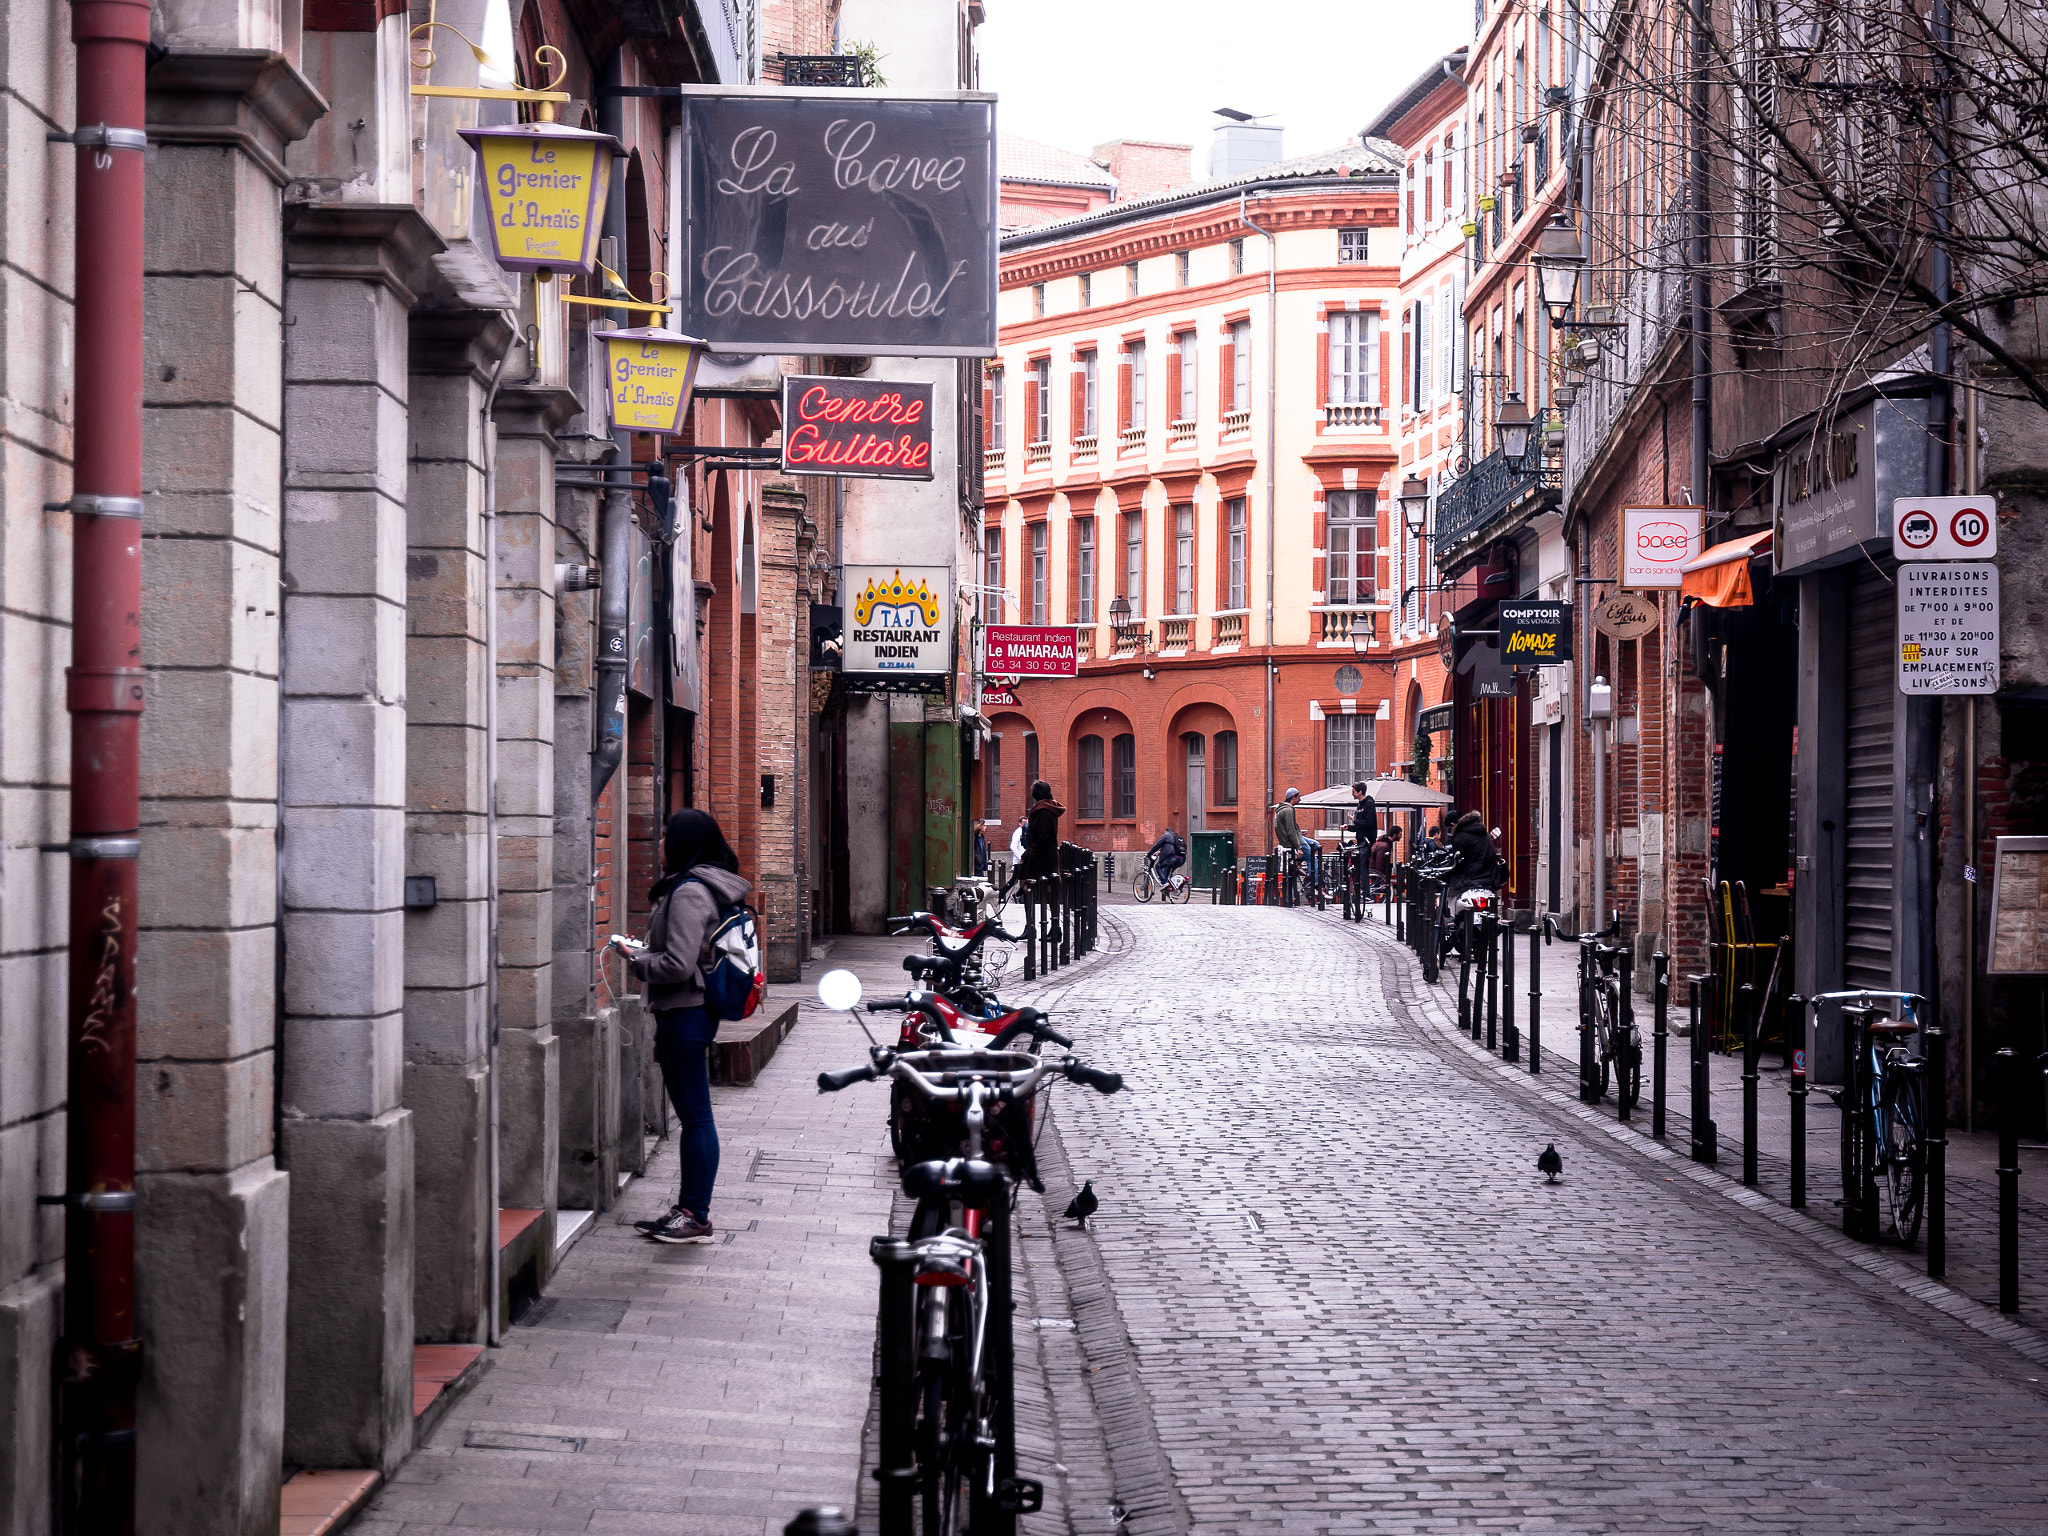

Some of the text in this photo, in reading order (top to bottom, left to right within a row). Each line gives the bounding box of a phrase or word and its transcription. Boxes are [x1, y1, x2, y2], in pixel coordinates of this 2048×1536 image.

[531, 141, 556, 164] Le
[717, 118, 966, 195] La Cave
[501, 200, 580, 229] d'Anaïs
[701, 246, 971, 319] Cassoulet
[641, 342, 659, 359] Le
[617, 383, 675, 407] d'Anaïs
[799, 384, 924, 424] Centre
[786, 423, 930, 468] Guitare
[1959, 519, 1981, 536] 10
[1637, 531, 1688, 549] boca
[1629, 566, 1644, 574] bar
[1909, 571, 1989, 581] LIVRAISONS
[1910, 587, 1988, 597] INTERDITES
[881, 609, 915, 628] TAJ
[1503, 609, 1560, 619] COMPTOIR
[853, 629, 941, 643] RESTAURANT
[992, 631, 1072, 643] Restaurant Indien
[1506, 630, 1557, 653] NOMADE
[874, 645, 919, 658] INDIEN
[988, 643, 1074, 659] Le MAHARAJA
[1920, 647, 1979, 656] SAUF SUR
[991, 659, 1071, 671] 05 34 30 50 12
[1903, 662, 1994, 673] EMPLACEMENTS
[1913, 678, 1986, 688] LIVSONS
